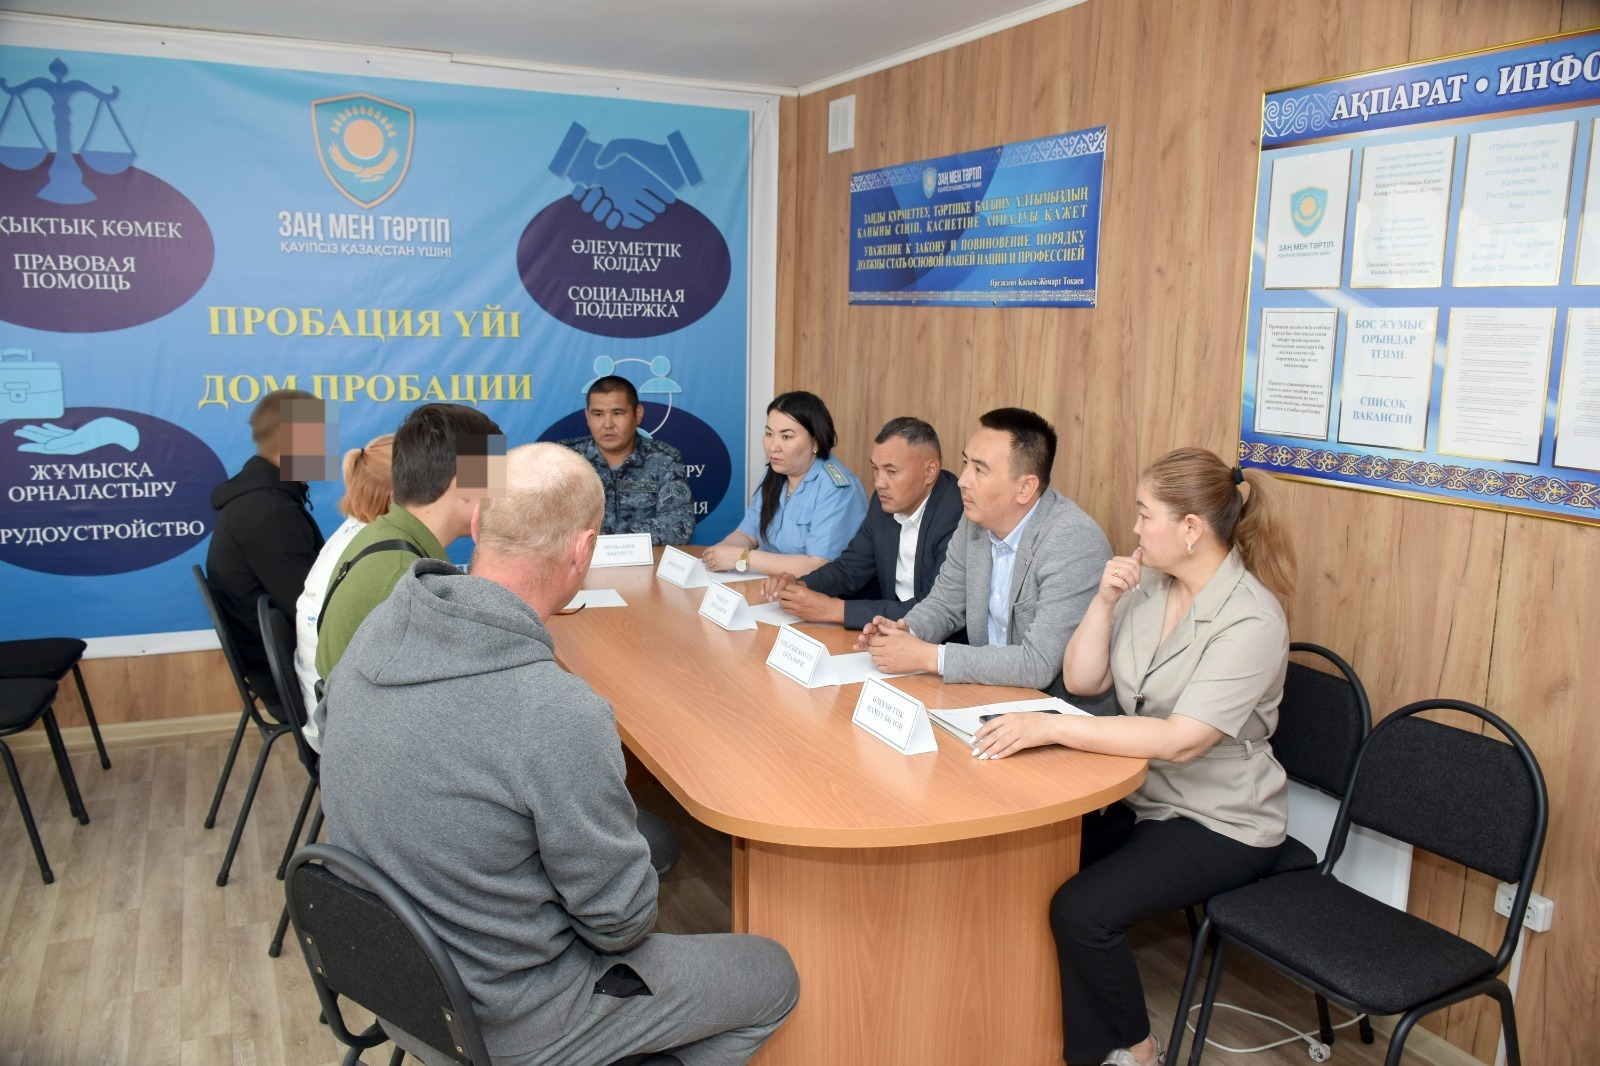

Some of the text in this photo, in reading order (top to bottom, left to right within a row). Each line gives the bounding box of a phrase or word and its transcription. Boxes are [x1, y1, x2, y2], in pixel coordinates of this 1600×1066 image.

[1330, 51, 1600, 122] АҚПАРАТ ИНФО
[934, 201, 971, 217] ТӘРТІПКЕ
[101, 219, 183, 238] КӨМЕК
[278, 210, 450, 243] ЗАҢ МЕН ТӘРТІП
[926, 216, 980, 234] ҚАСИЕТІНЕ
[1045, 204, 1087, 224] ҚАЖЕТ
[280, 241, 452, 258] ҚАУІПСІЗ ҚАЗАҚСТАН ҮШІН!
[571, 239, 682, 258] ӘЛЕУМЕТТІК
[864, 229, 1086, 257] УВАЖЕНИЕ К ЗАКОНУ И ПОВИНОВЕНИЕ ПОРЯДКУ
[13, 253, 136, 273] ПРАВОВАЯ
[593, 255, 661, 273] ҚОЛДАУ
[856, 244, 1085, 272] ДОЛЖНЫ СТАТЬ ОСНОВОЙ НАШЕЙ НАЦИИ И ПРОФЕССИЕЙ
[22, 272, 131, 293] ПОМОЩЬ
[568, 286, 685, 303] СОЦИАЛЬНАЯ
[575, 302, 679, 319] ПОДДЕРЖКА
[207, 304, 522, 343] ПРОБАЦИЯ ҮЙІ
[1355, 319, 1376, 329] БОС
[1361, 334, 1416, 345] ОРЫНДАР
[1370, 349, 1404, 360] ТІЗІМІ
[198, 374, 534, 410] ДОМ ПРОБАЦИИ
[1360, 396, 1407, 409] СПИСОК
[1353, 410, 1412, 425] ВАКАНСИЙ
[30, 461, 154, 481] ЖҰМЫСҚА
[683, 464, 706, 478] РУ
[8, 481, 177, 502] ОРНАЛАСТЫРУ
